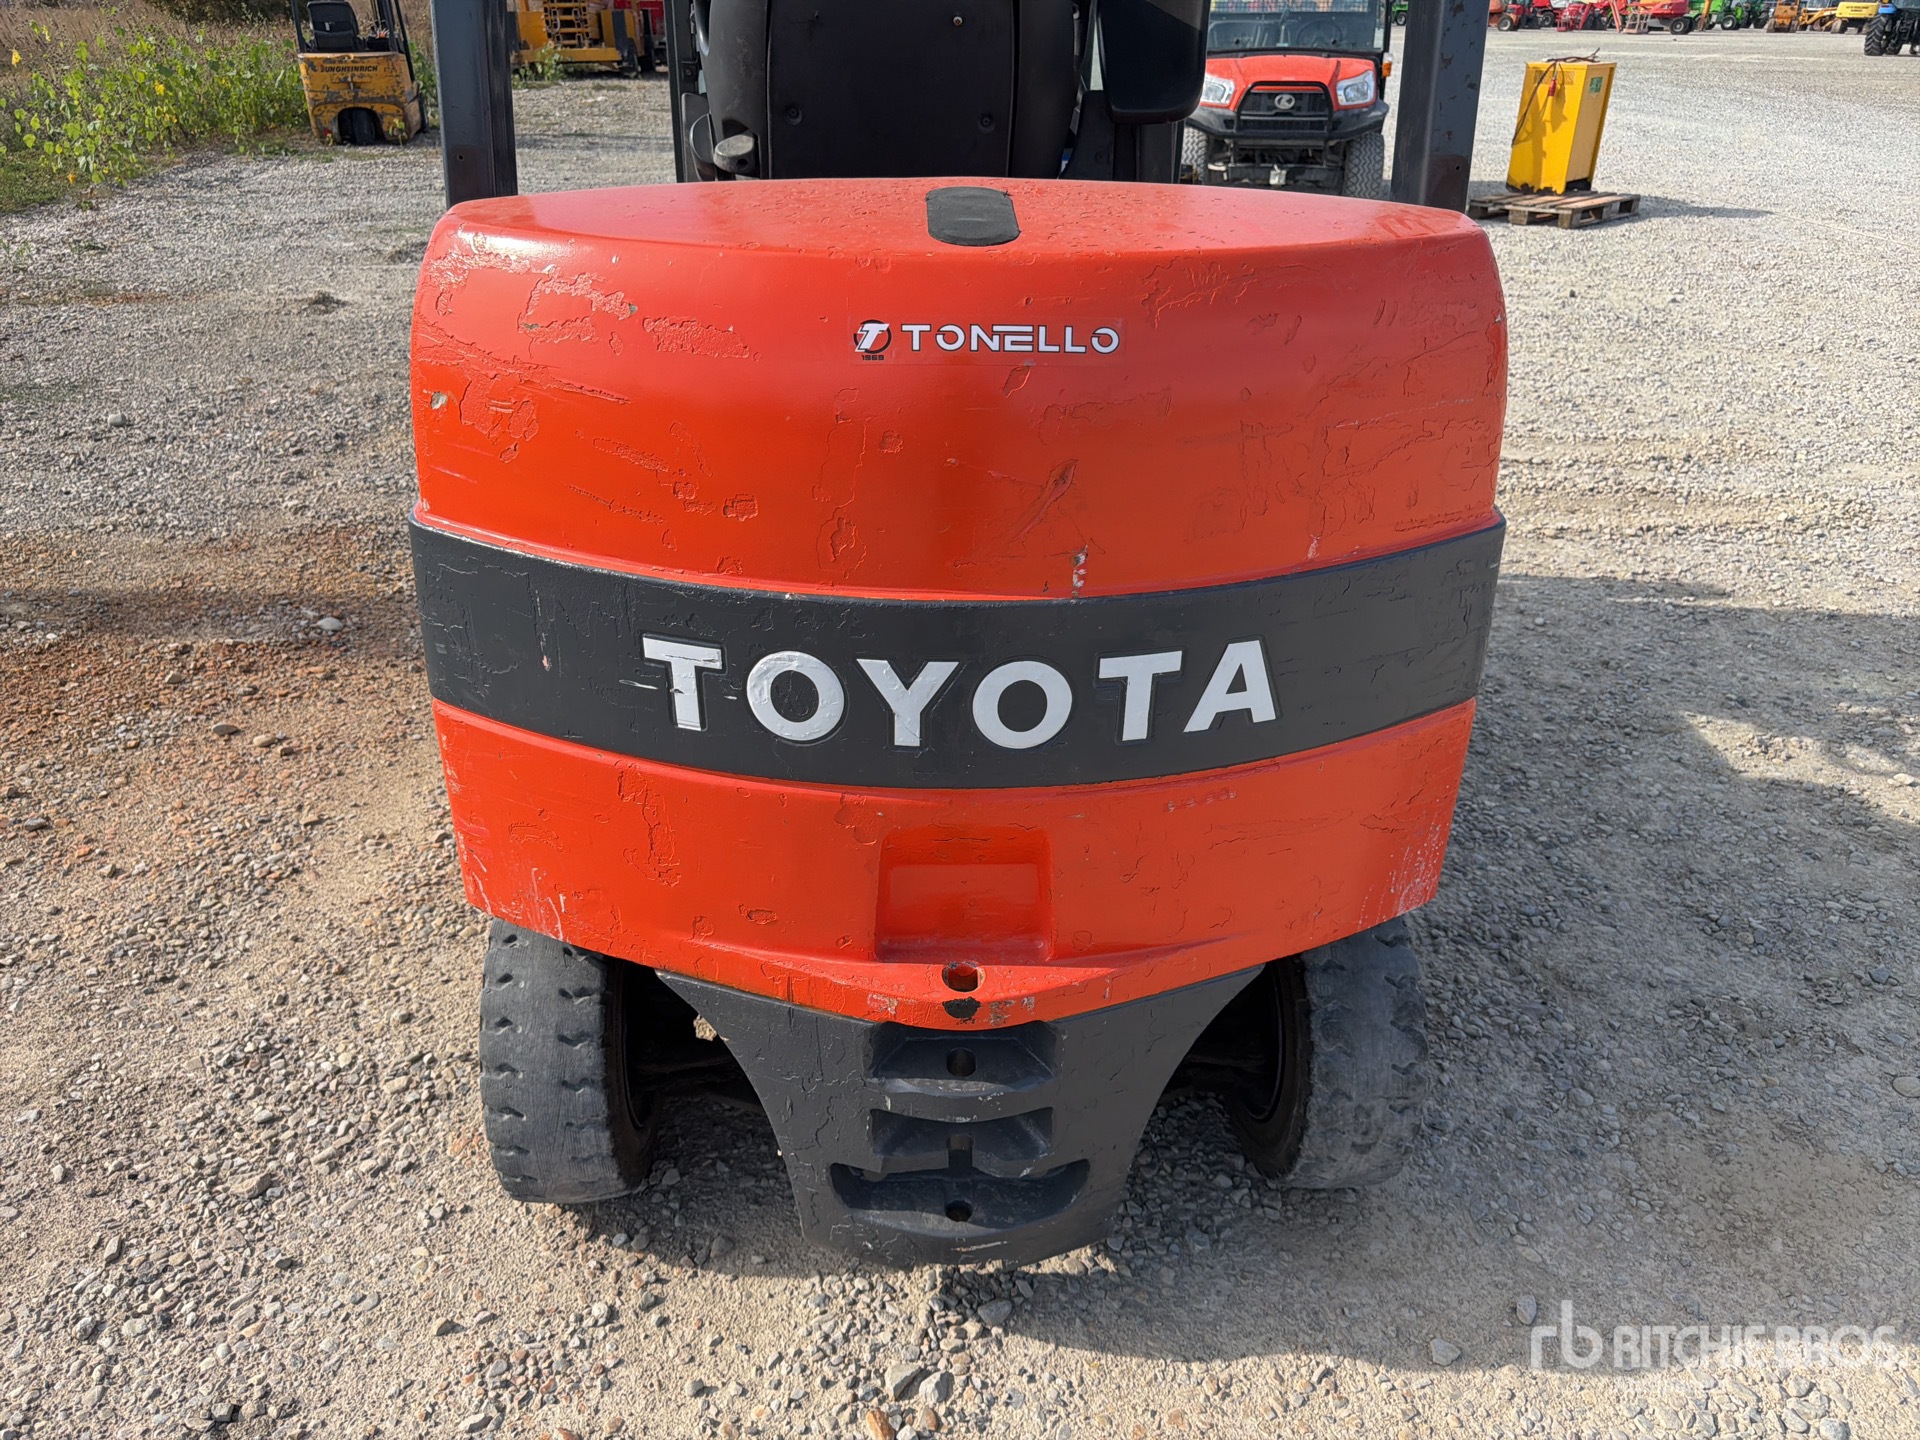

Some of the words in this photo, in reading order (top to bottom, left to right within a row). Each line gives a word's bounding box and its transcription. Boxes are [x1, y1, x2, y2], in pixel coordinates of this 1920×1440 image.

[321, 65, 378, 73] JUNGHEINRICH
[901, 323, 1120, 354] TONELLO
[642, 634, 1278, 750] TOYOTA
